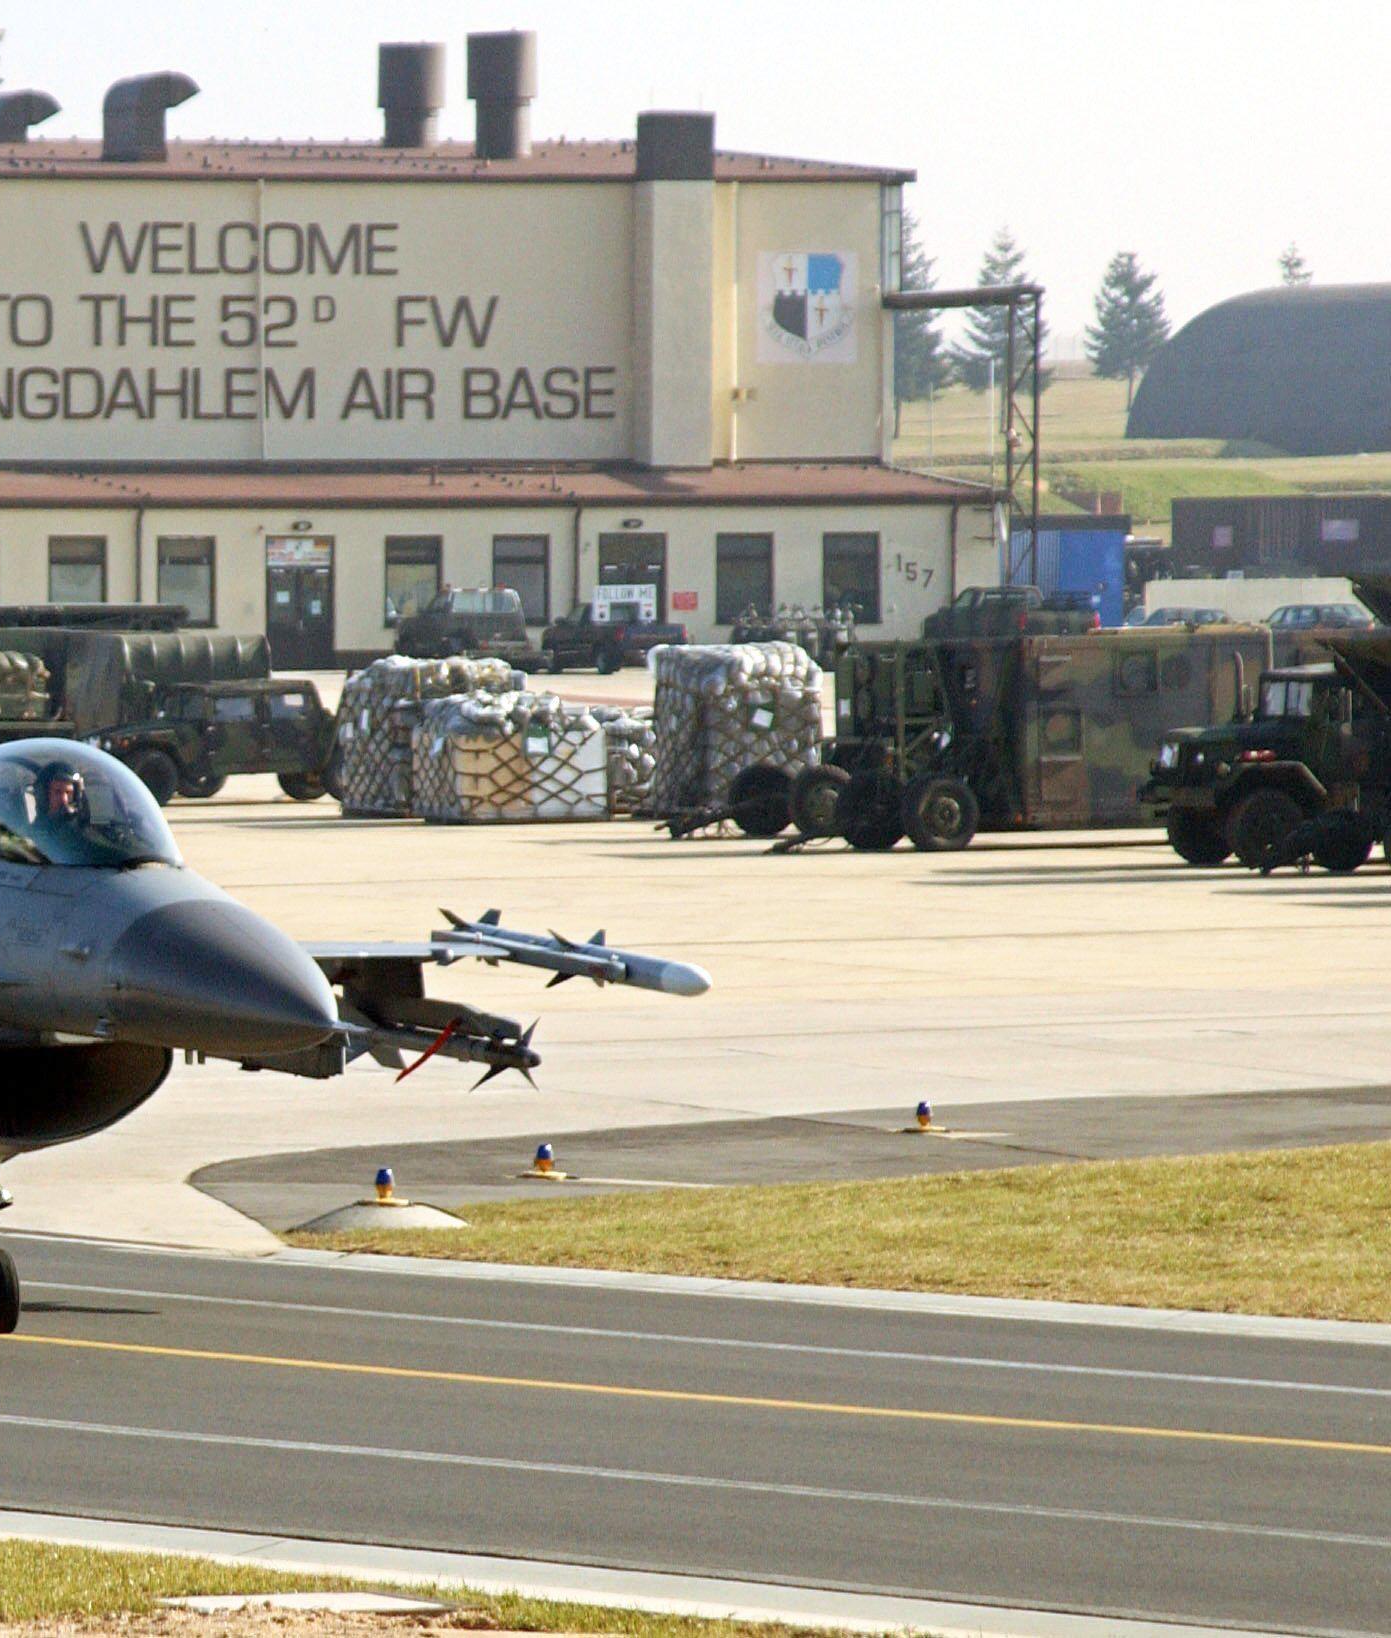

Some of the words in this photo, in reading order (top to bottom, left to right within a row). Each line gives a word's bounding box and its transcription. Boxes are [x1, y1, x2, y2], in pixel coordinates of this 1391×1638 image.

[79, 222, 399, 277] WELCOME
[78, 293, 196, 348] THE
[395, 295, 499, 349] FW
[340, 367, 436, 421] AIR
[462, 367, 617, 421] BASE
[597, 588, 635, 601] FOLLOW
[639, 587, 654, 600] ME
[896, 553, 934, 589] 157
